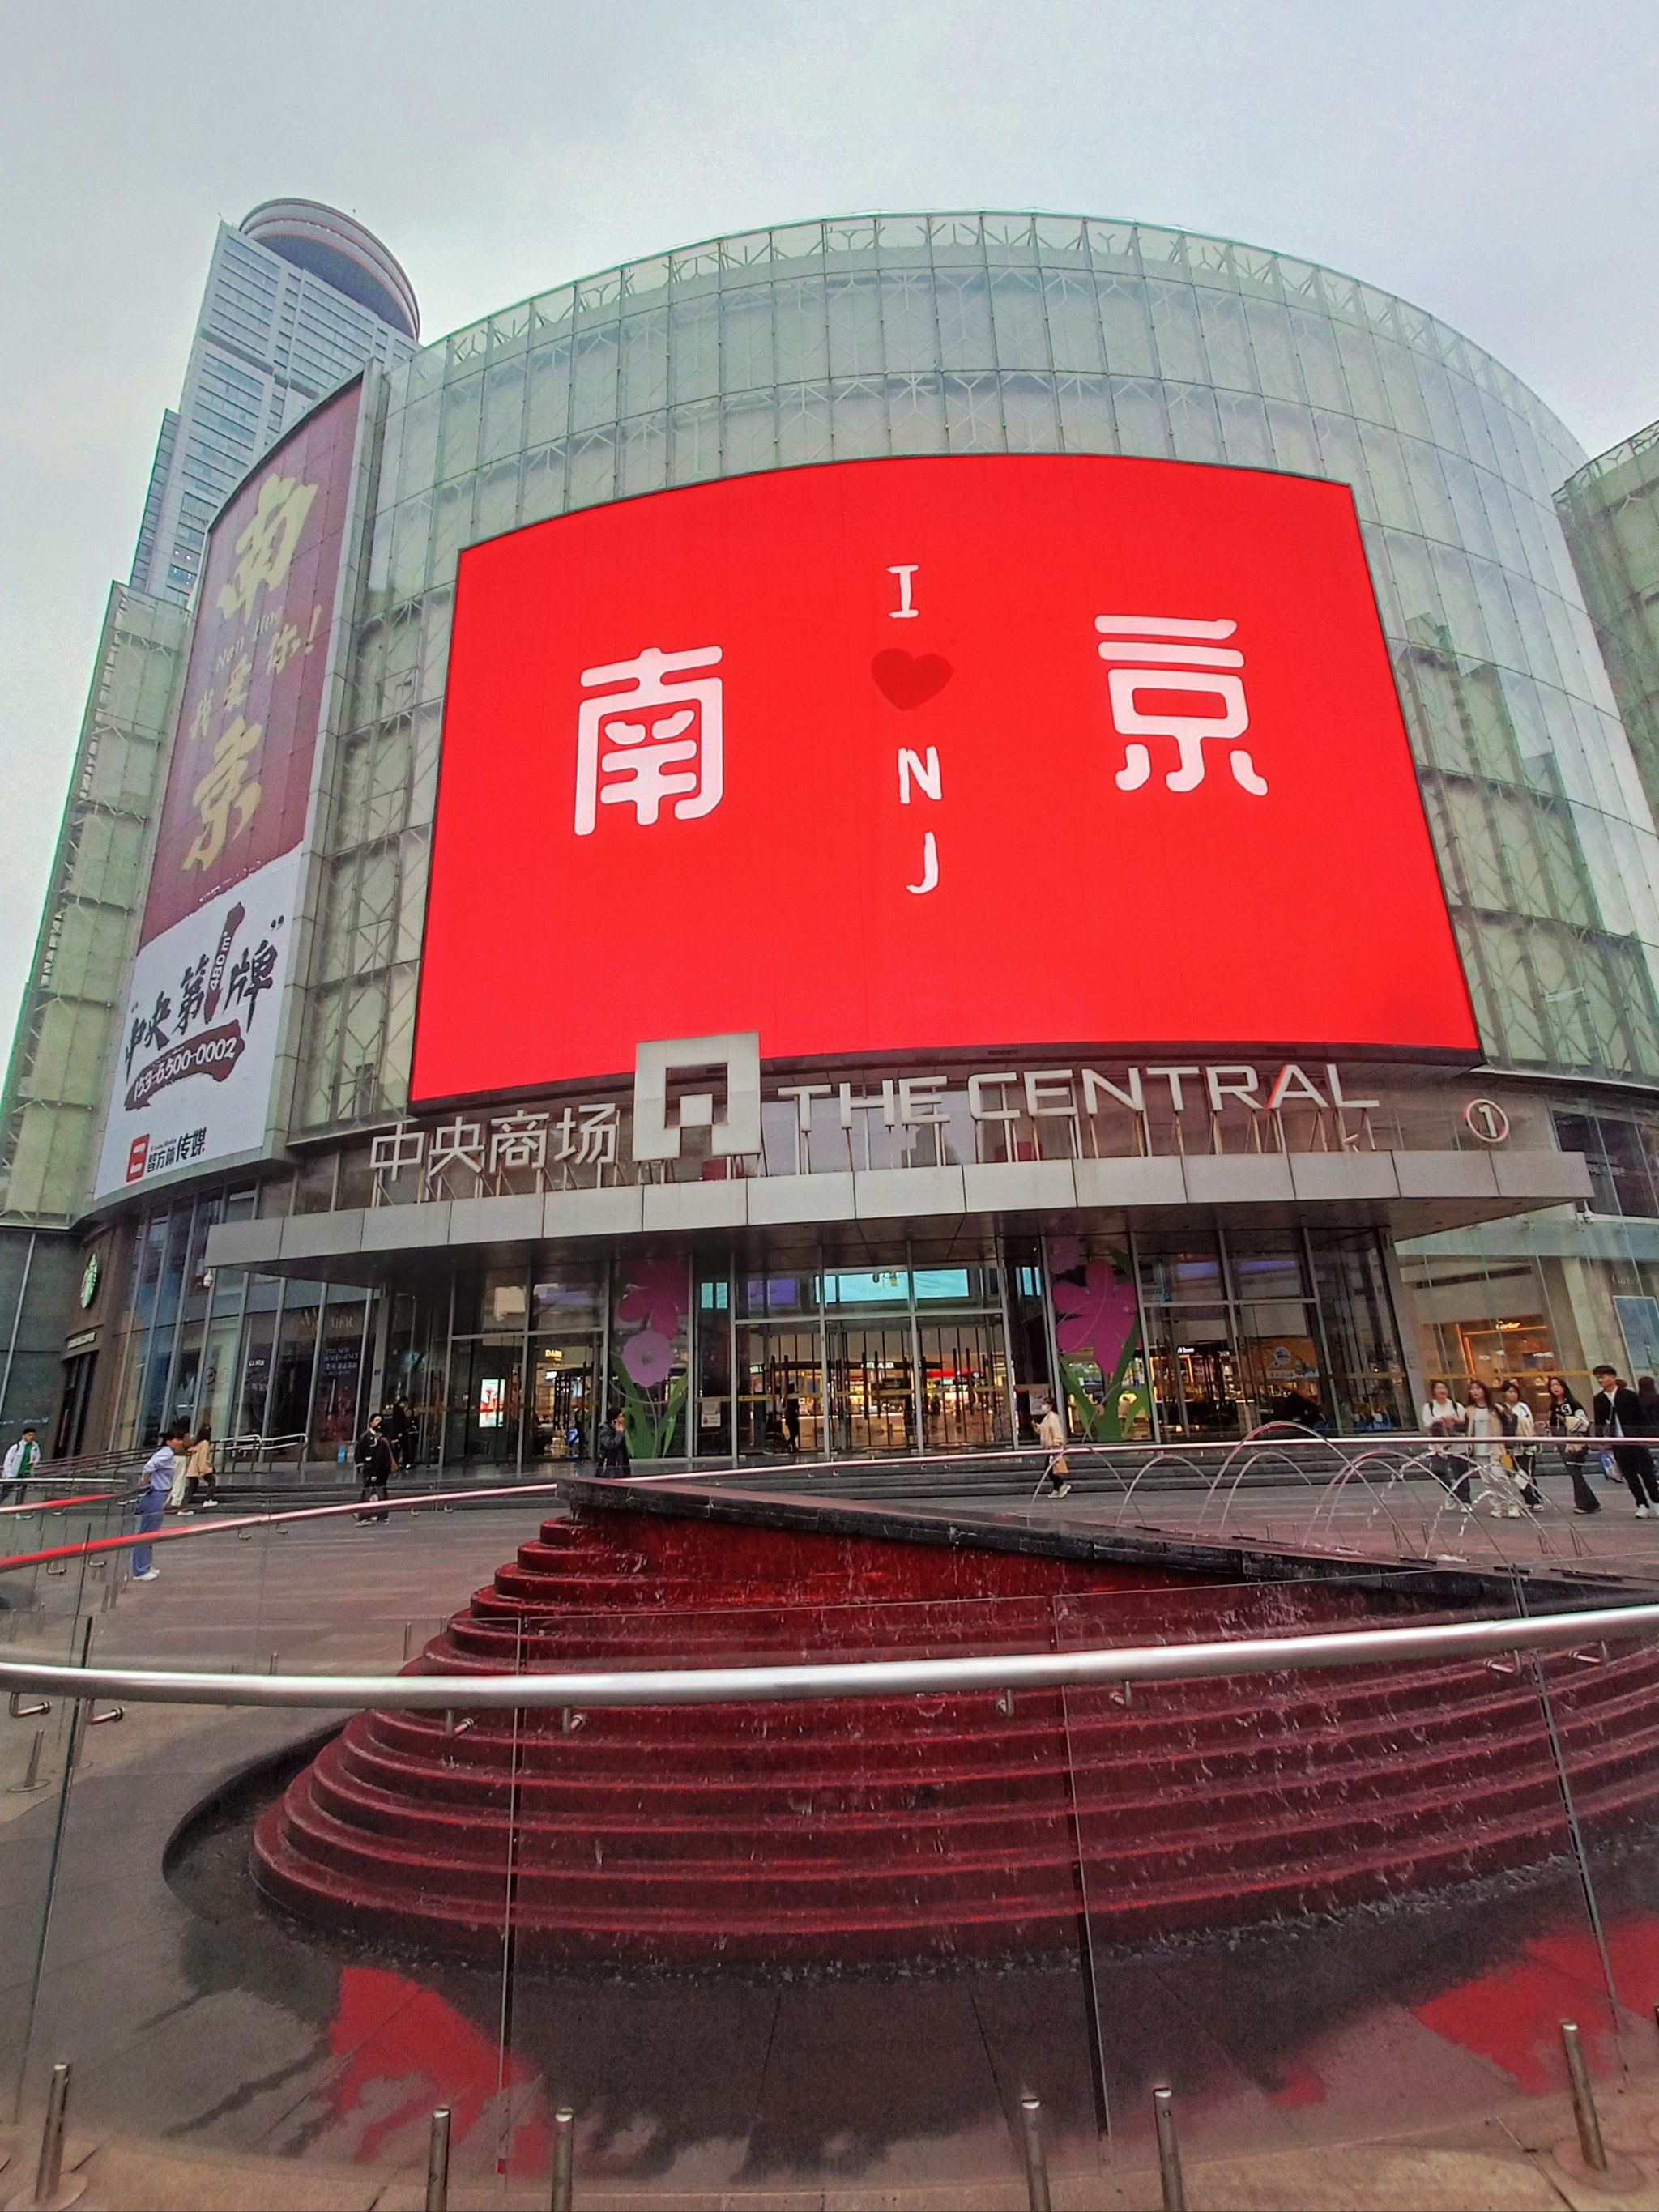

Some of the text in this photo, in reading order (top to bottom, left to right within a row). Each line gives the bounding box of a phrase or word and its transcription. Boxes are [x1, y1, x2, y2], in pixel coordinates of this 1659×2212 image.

[574, 646, 723, 836] 南
[1094, 615, 1269, 796] 京
[369, 1102, 617, 1182] 中央商场
[777, 1063, 1380, 1133] THE CENTRAL
